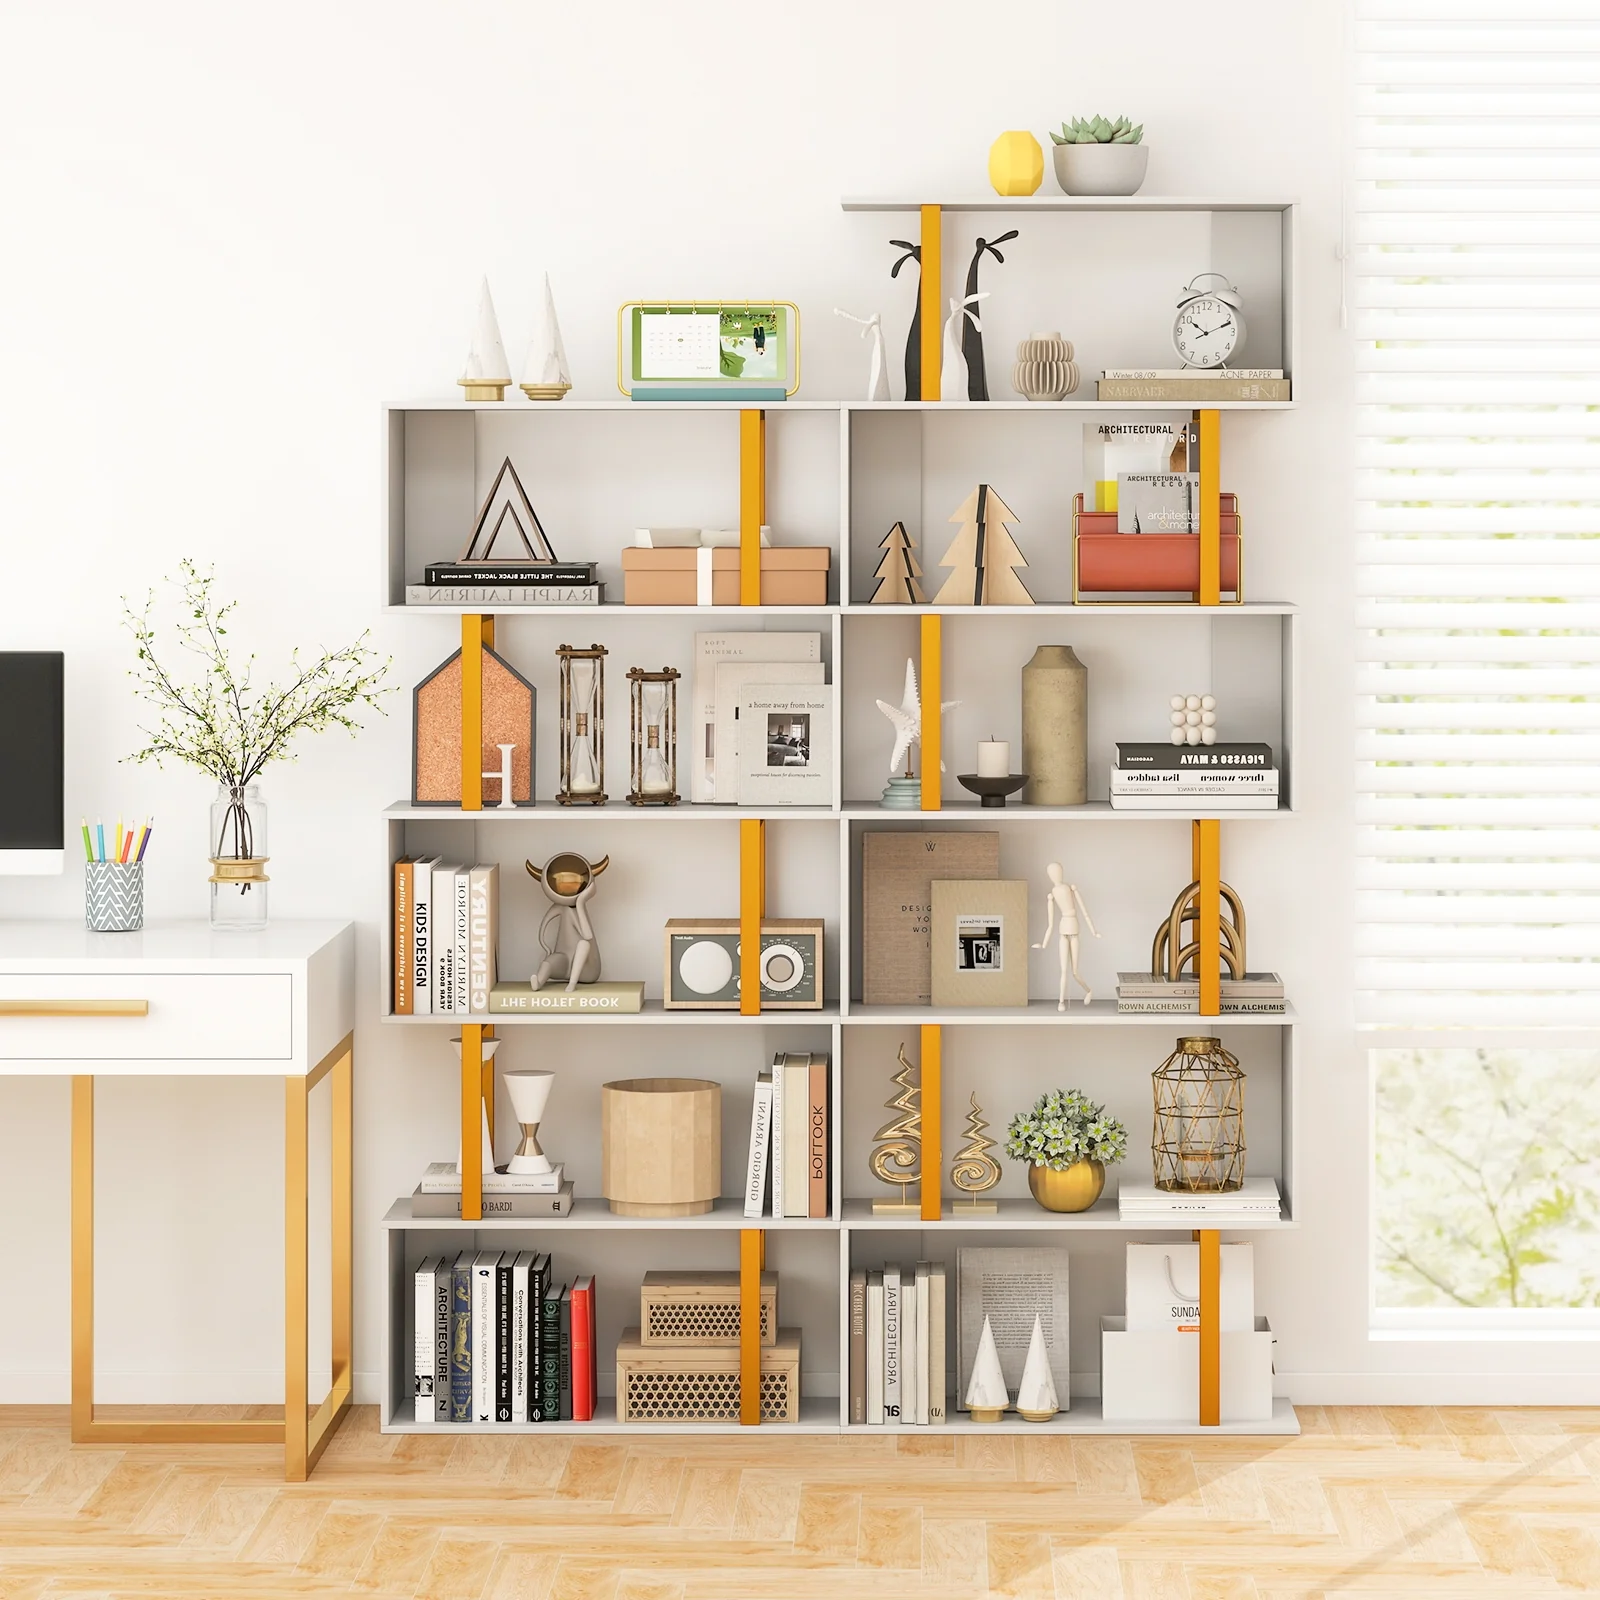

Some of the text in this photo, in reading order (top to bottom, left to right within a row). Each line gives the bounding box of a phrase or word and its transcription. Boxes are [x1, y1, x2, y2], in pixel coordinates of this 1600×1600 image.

[1191, 306, 1201, 314] 11
[1202, 302, 1213, 311] 12
[1217, 305, 1221, 313] 1
[1182, 316, 1192, 324] 10
[1226, 314, 1232, 322] 2
[1177, 328, 1183, 336] 9
[1231, 328, 1236, 336] 3
[1180, 342, 1186, 350] 8
[1225, 343, 1231, 351] 4
[1190, 351, 1195, 360] 7
[1202, 355, 1209, 364] 6
[1215, 352, 1221, 361] 5
[1112, 371, 1272, 379] Winter 08/09 ACNE PAPER
[1099, 426, 1174, 434] ARCHITECTURAL
[1148, 506, 1200, 520] architectur
[1159, 520, 1200, 529] &mone
[398, 873, 406, 913] simplicity
[416, 903, 427, 987] KIDS DESIGN
[398, 935, 406, 977] everything
[400, 980, 405, 990] we
[489, 1202, 513, 1212] BARDI
[1172, 1306, 1200, 1317] SUNDA
[439, 1287, 448, 1382] ARCHITECTURE
